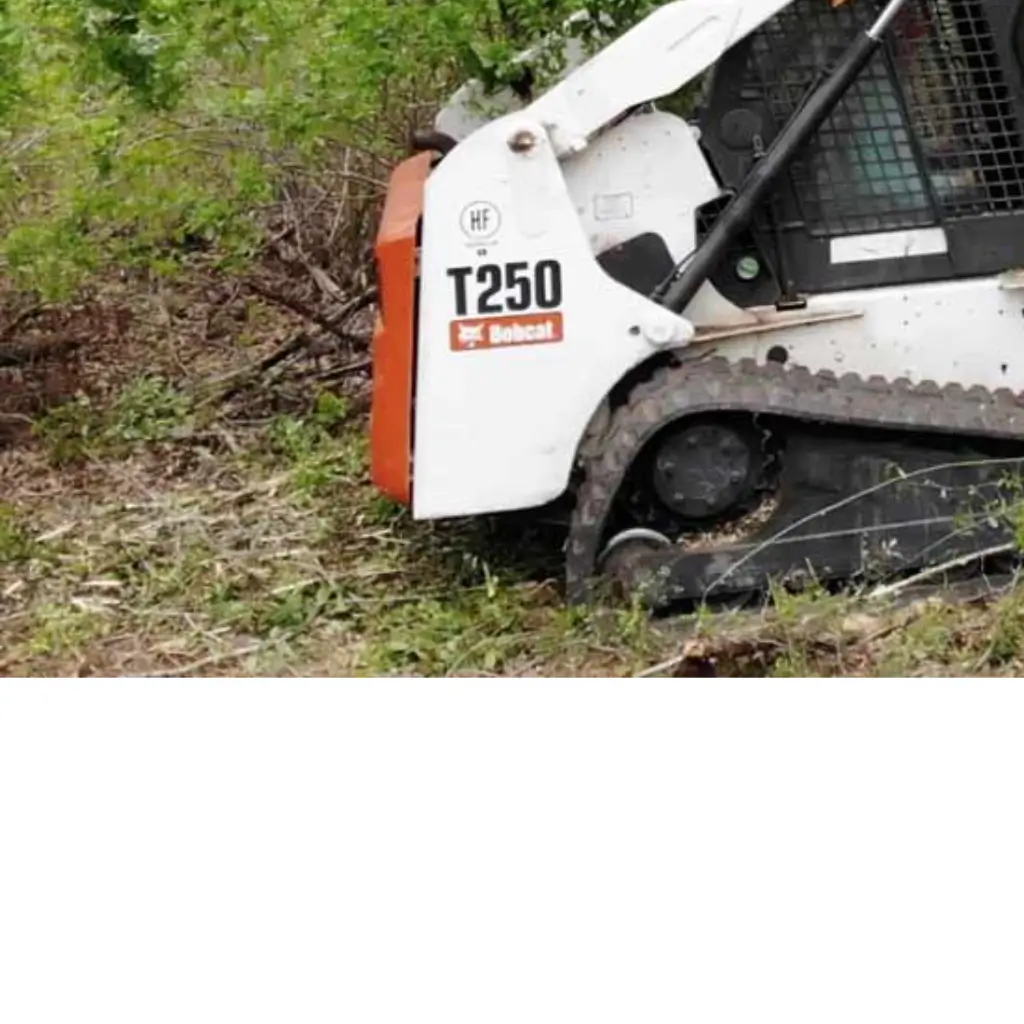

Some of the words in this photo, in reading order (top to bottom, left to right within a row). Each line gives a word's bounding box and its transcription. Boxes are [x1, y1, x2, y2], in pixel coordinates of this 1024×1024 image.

[470, 209, 490, 231] HF
[446, 259, 562, 316] T250
[488, 320, 554, 344] Bobcat
